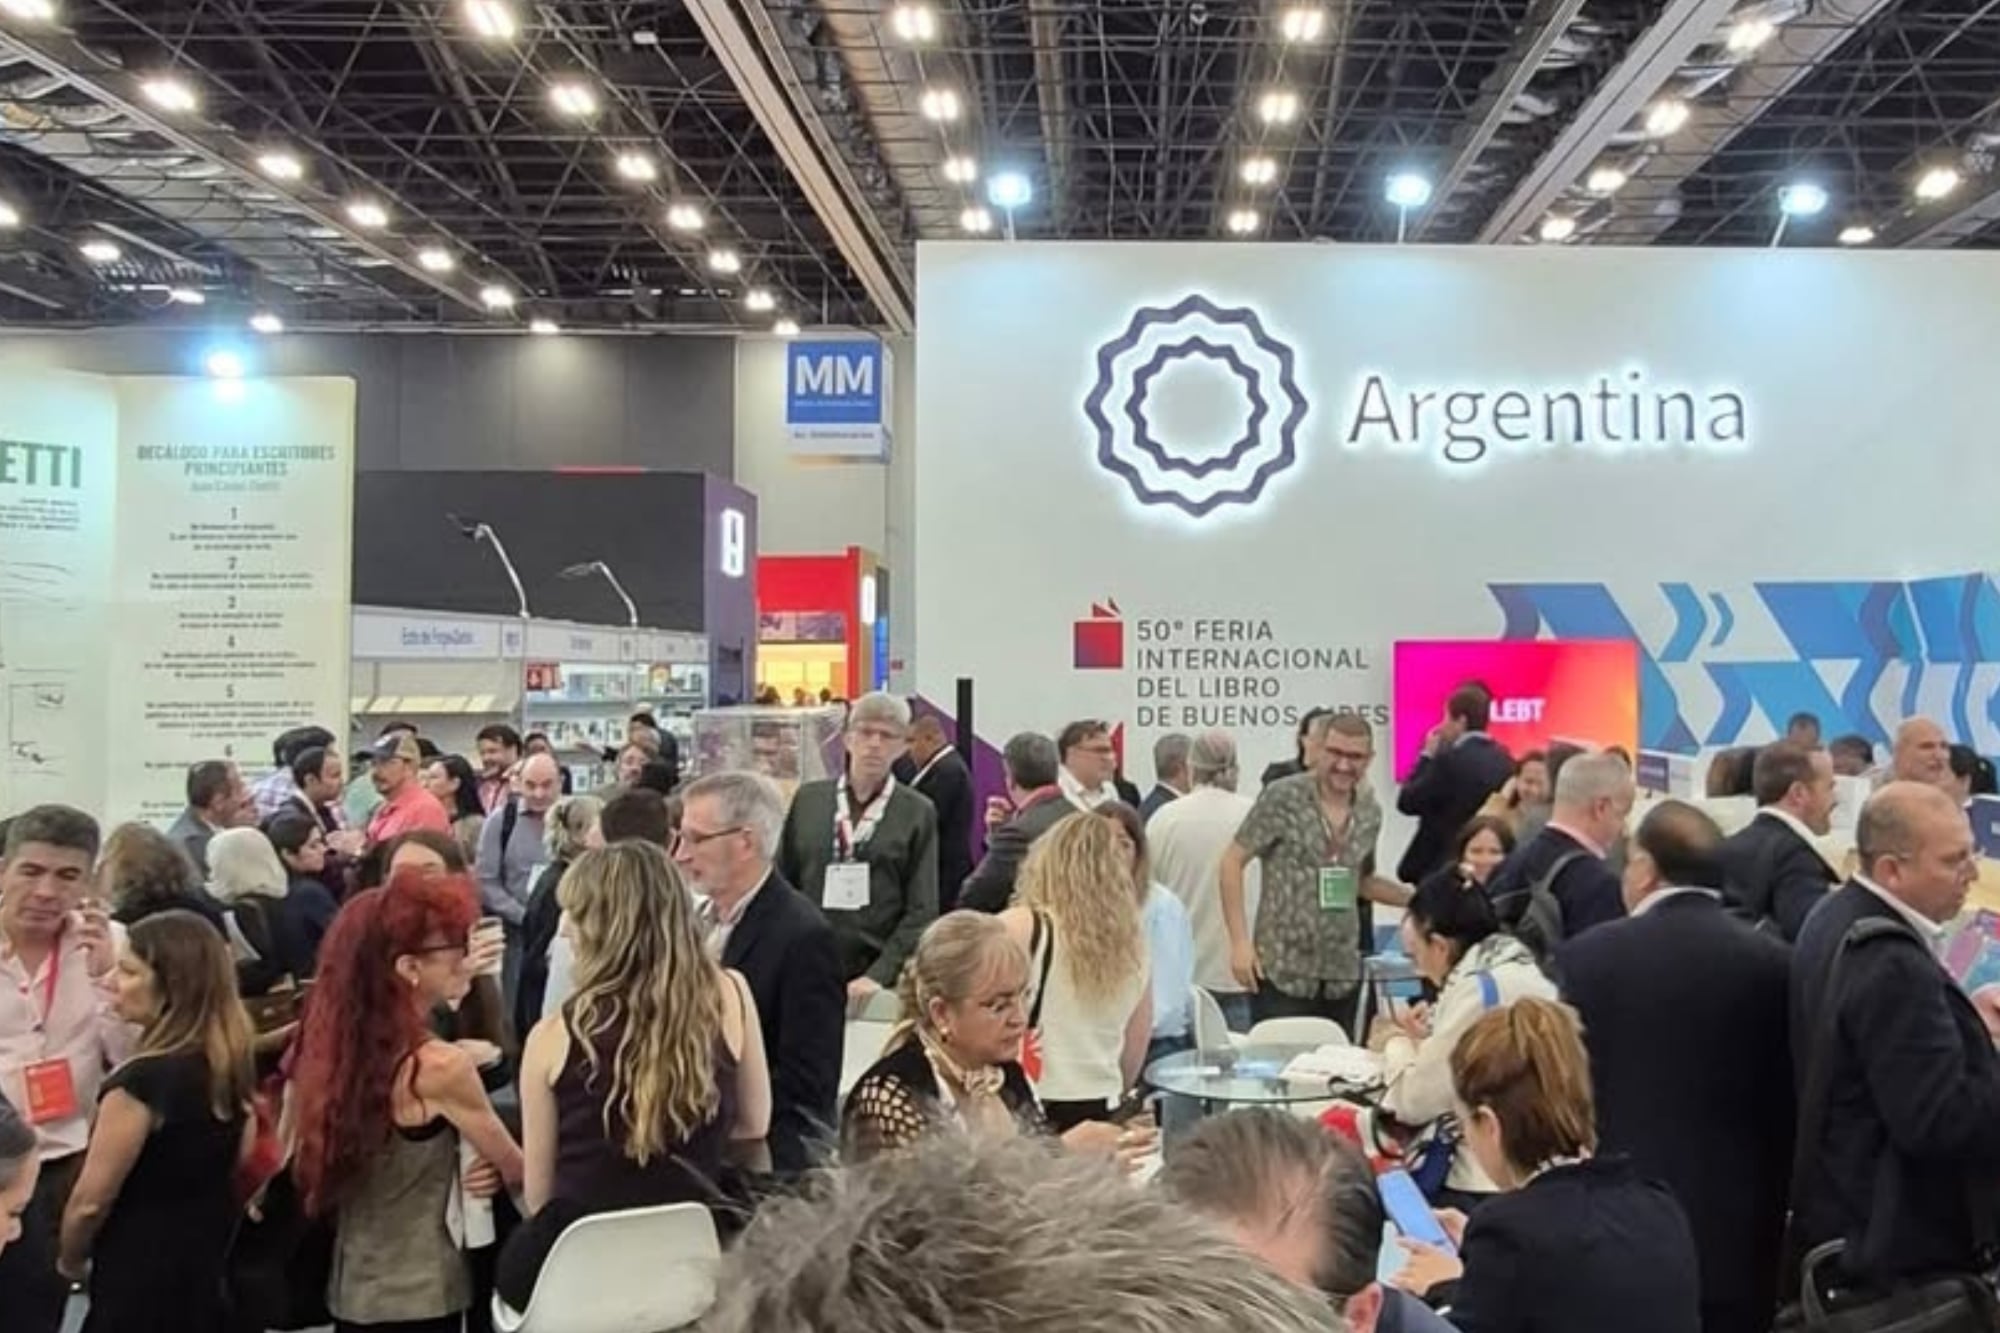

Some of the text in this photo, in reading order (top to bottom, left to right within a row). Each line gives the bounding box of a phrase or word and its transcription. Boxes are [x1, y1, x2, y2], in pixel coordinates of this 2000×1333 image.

[795, 355, 873, 395] MM
[1348, 372, 1745, 464] Argentina
[0, 441, 81, 488] ETTI
[1194, 619, 1273, 641] FERIA
[1136, 648, 1369, 669] INTERNACIONAL
[1136, 677, 1280, 698] DEL LIBRO
[1136, 706, 1172, 727] DE
[1182, 706, 1298, 727] BUENOS
